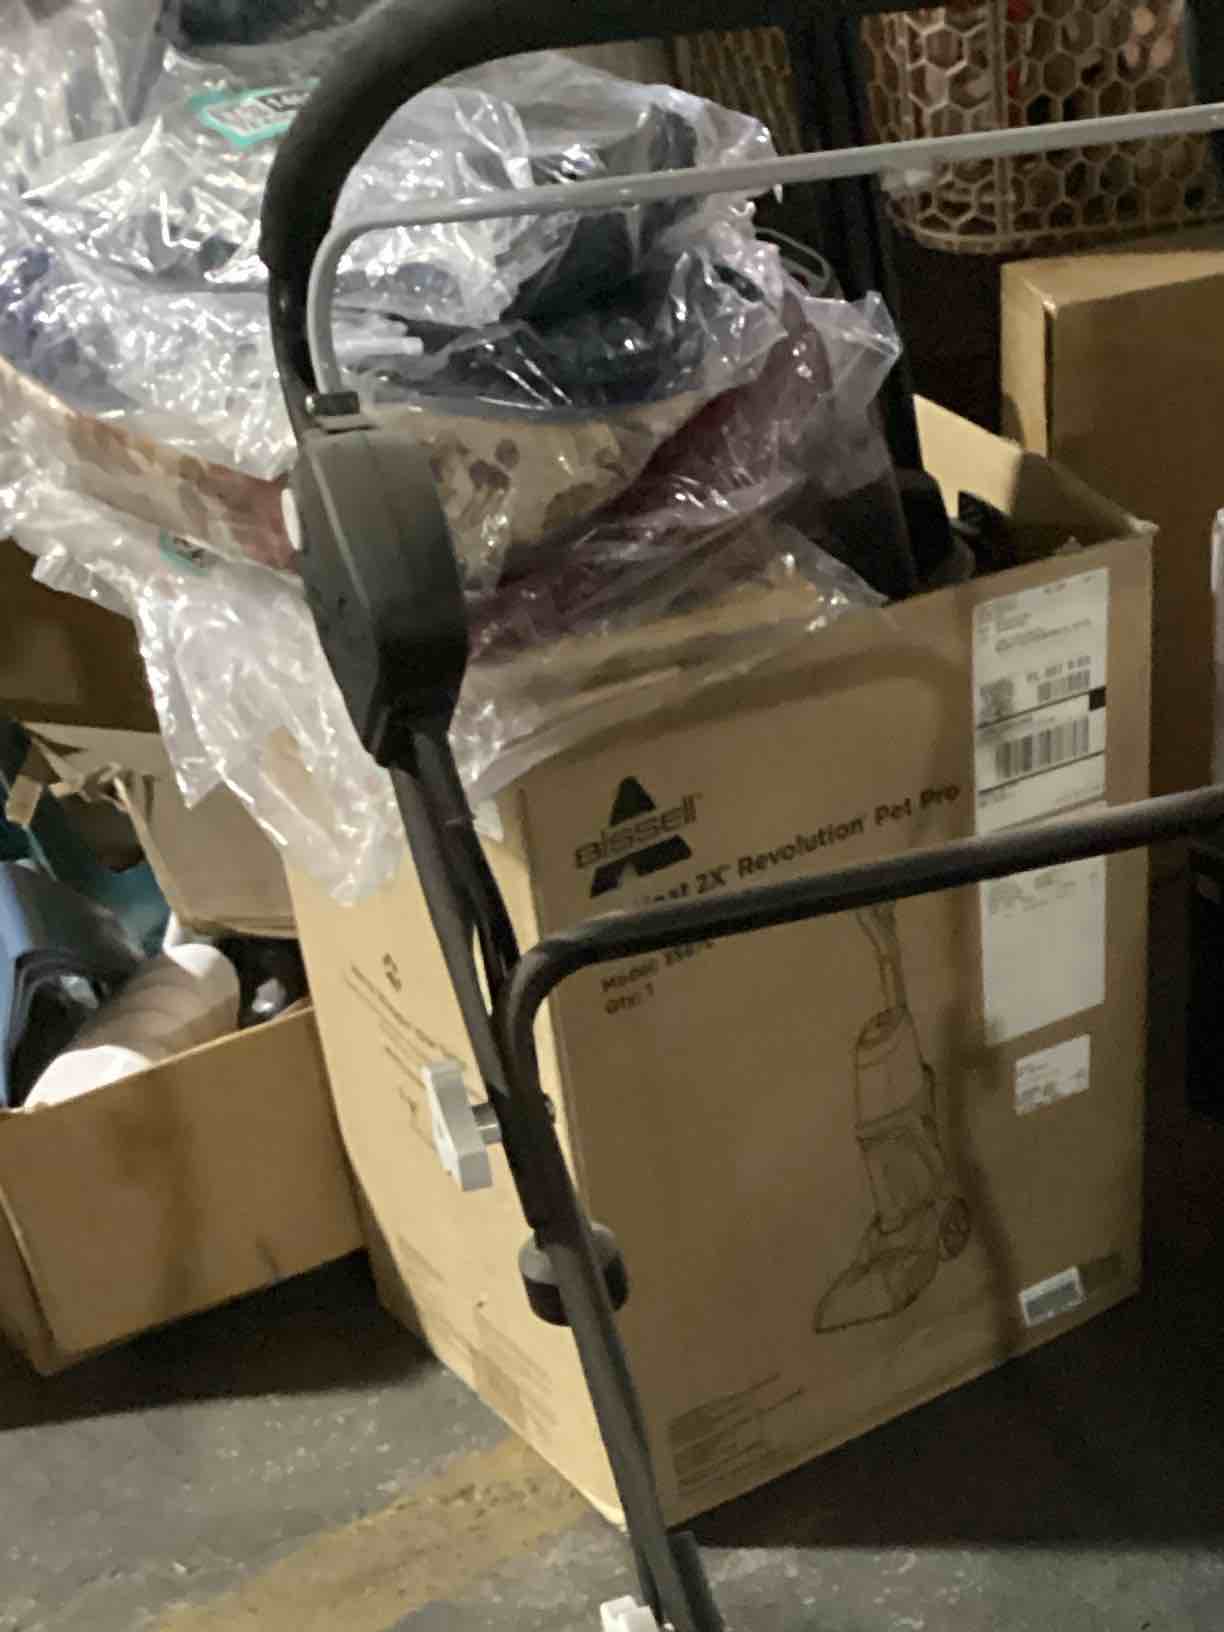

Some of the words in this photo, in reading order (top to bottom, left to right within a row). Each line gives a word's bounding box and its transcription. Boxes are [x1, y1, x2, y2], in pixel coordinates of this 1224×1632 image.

[738, 820, 864, 879] Revolution
[874, 798, 912, 826] Pet
[920, 783, 961, 810] Pro
